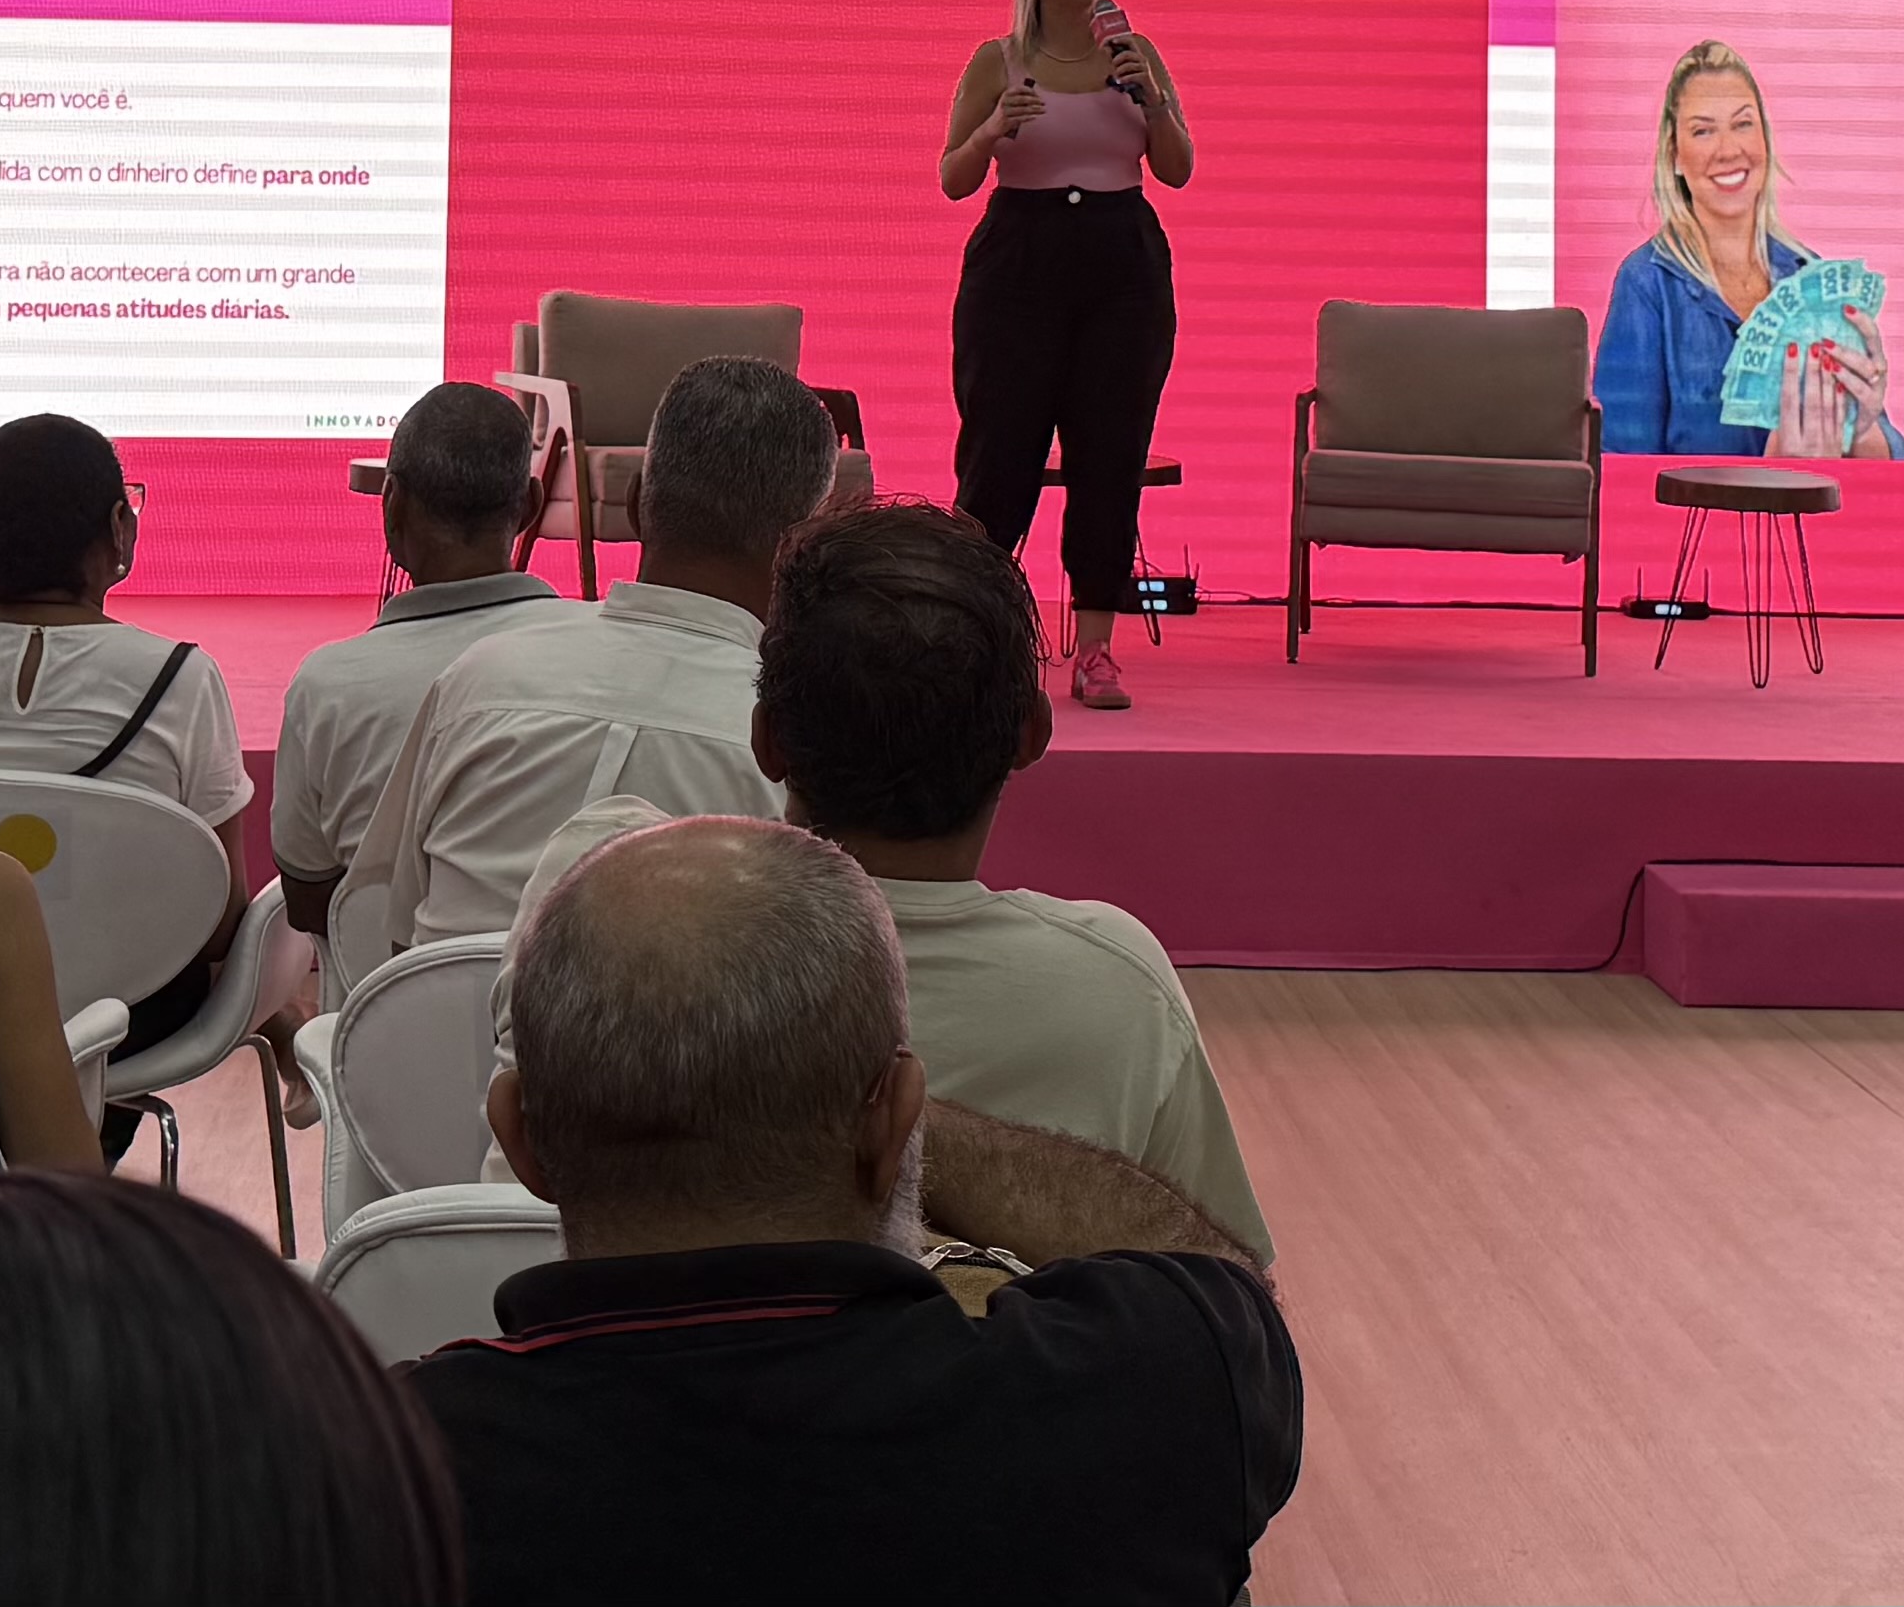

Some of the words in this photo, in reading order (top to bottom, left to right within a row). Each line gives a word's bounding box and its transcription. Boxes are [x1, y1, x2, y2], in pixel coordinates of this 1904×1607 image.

[61, 89, 109, 109] você
[115, 89, 132, 109] é.
[38, 166, 82, 182] com
[89, 167, 101, 182] o
[108, 163, 188, 183] dinheiro
[194, 164, 257, 184] define
[263, 169, 313, 188] para
[319, 165, 370, 185] onde
[27, 261, 65, 281] não
[70, 261, 190, 282] acontecerá
[197, 266, 240, 282] com
[247, 267, 276, 283] um
[282, 264, 355, 288] grande
[7, 301, 110, 321] pequenas
[116, 298, 206, 318] atitudes
[211, 299, 289, 319] diárias.
